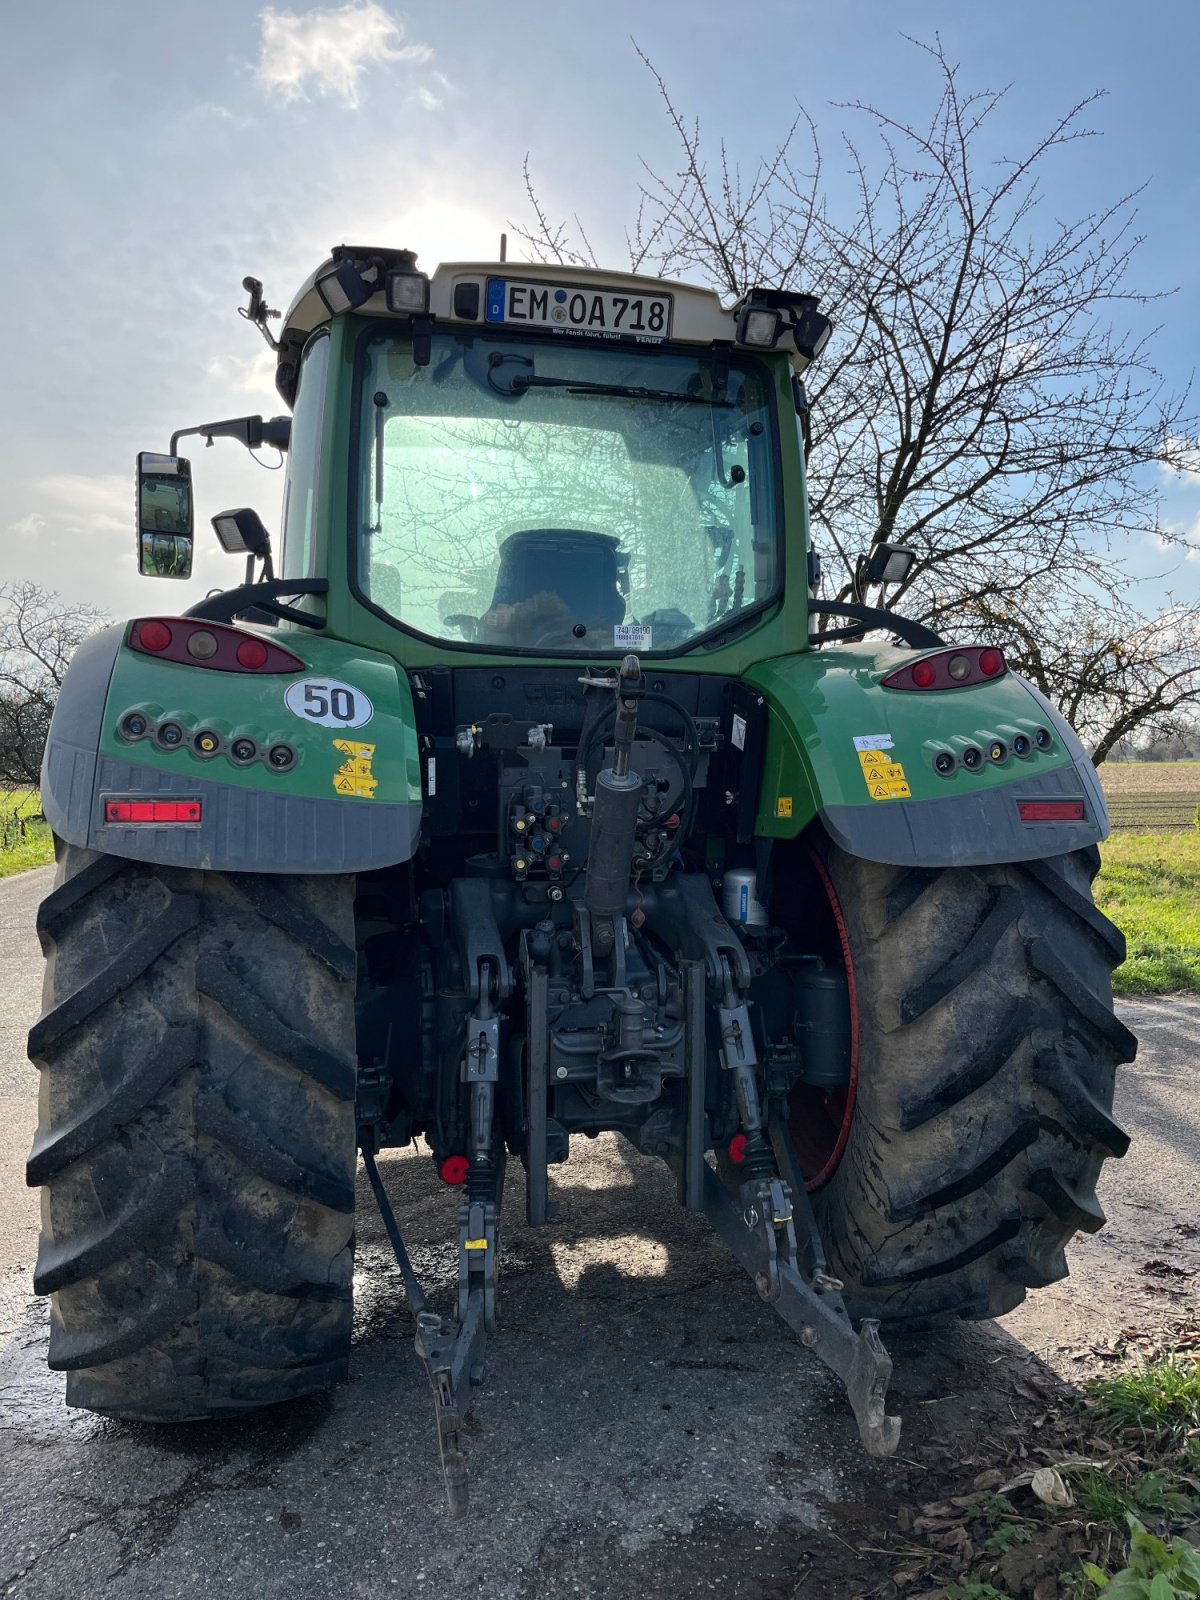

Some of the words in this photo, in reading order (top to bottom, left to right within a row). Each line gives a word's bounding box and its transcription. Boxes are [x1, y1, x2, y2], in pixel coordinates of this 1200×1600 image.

[492, 304, 500, 315] D
[509, 287, 548, 321] EM
[612, 298, 665, 332] 718
[635, 336, 664, 345] FENDT
[304, 684, 356, 721] 50
